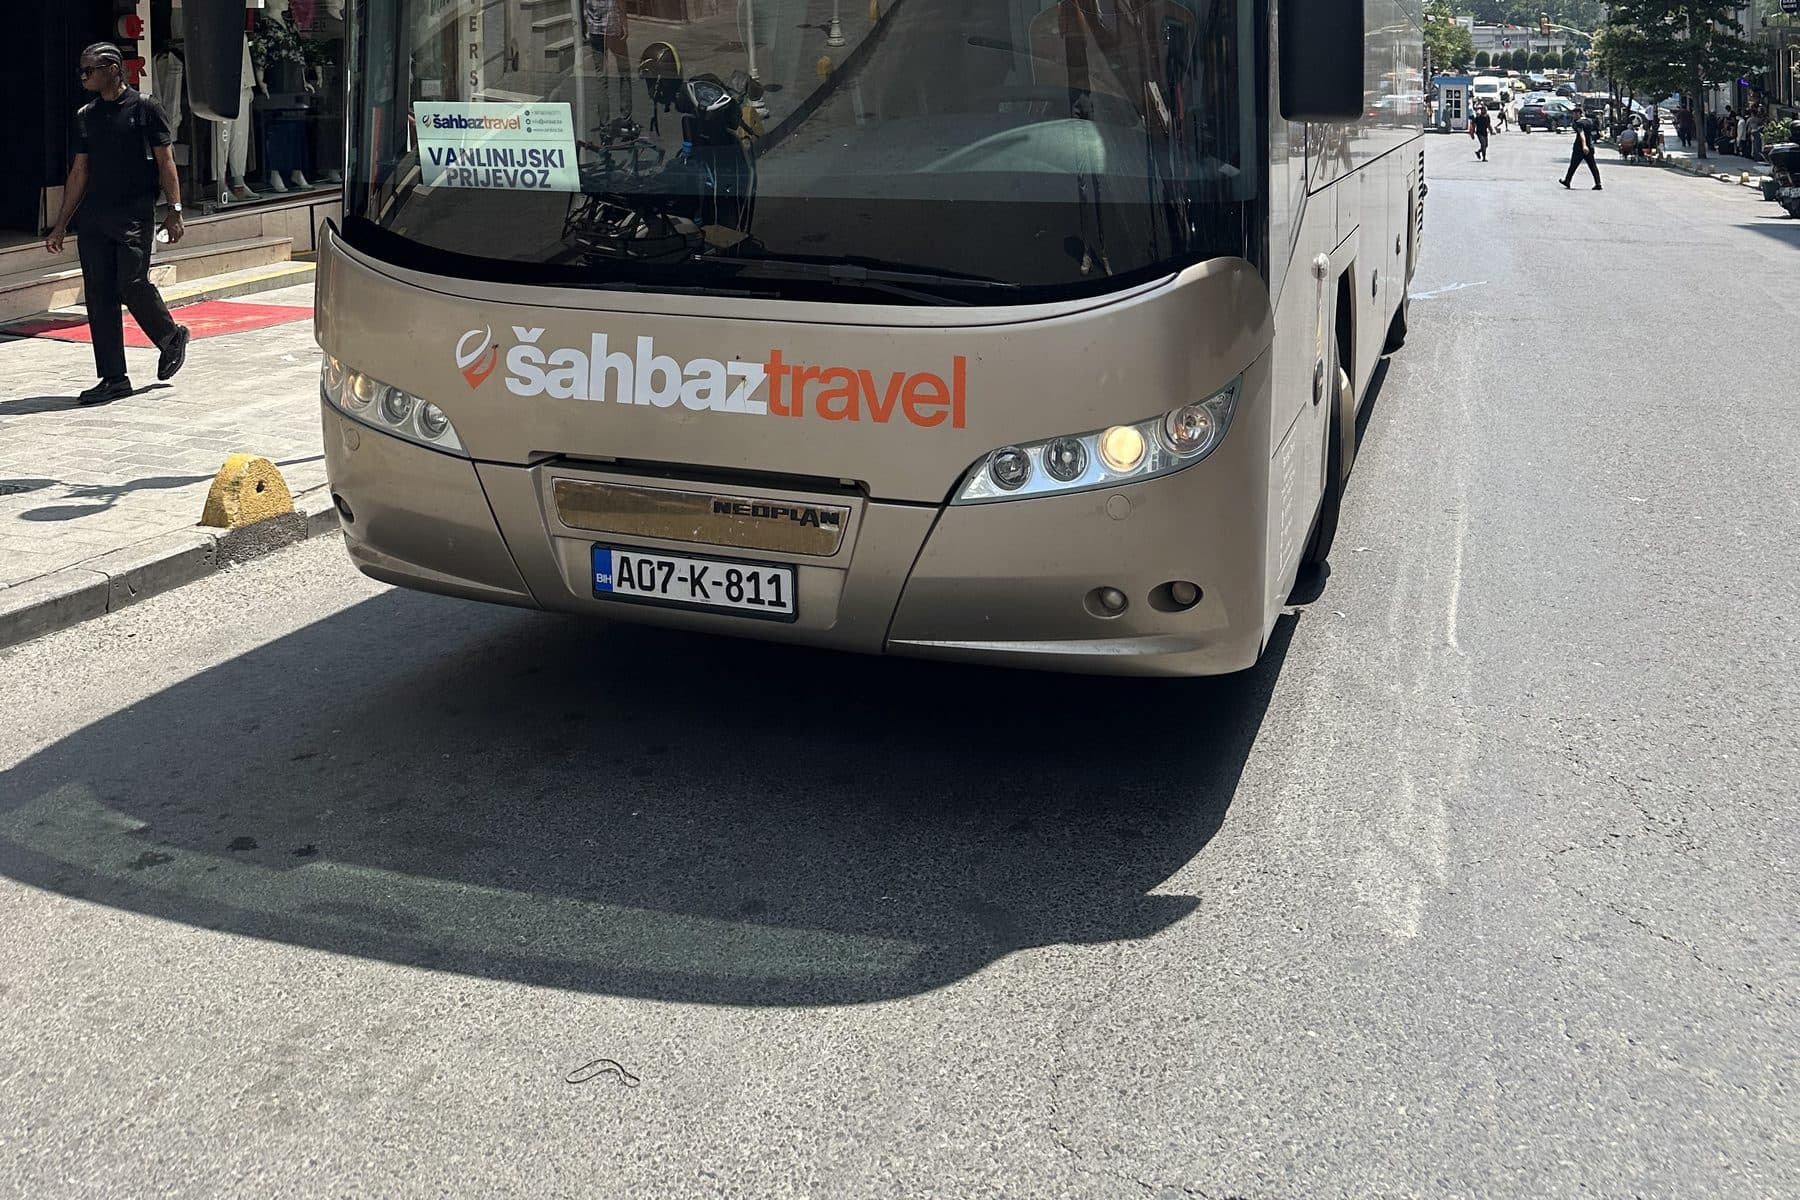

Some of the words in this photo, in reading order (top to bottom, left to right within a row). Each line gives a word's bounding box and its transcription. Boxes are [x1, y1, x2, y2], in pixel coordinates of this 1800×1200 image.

[432, 113, 521, 131] šahbaztravel
[428, 147, 565, 169] VANLINIJSKI
[446, 167, 552, 189] PRIJEVOZ
[505, 325, 966, 430] šahbaztravel
[713, 501, 840, 528] NEOPLAN
[596, 573, 612, 585] BIH
[616, 555, 787, 609] A07-K-811
